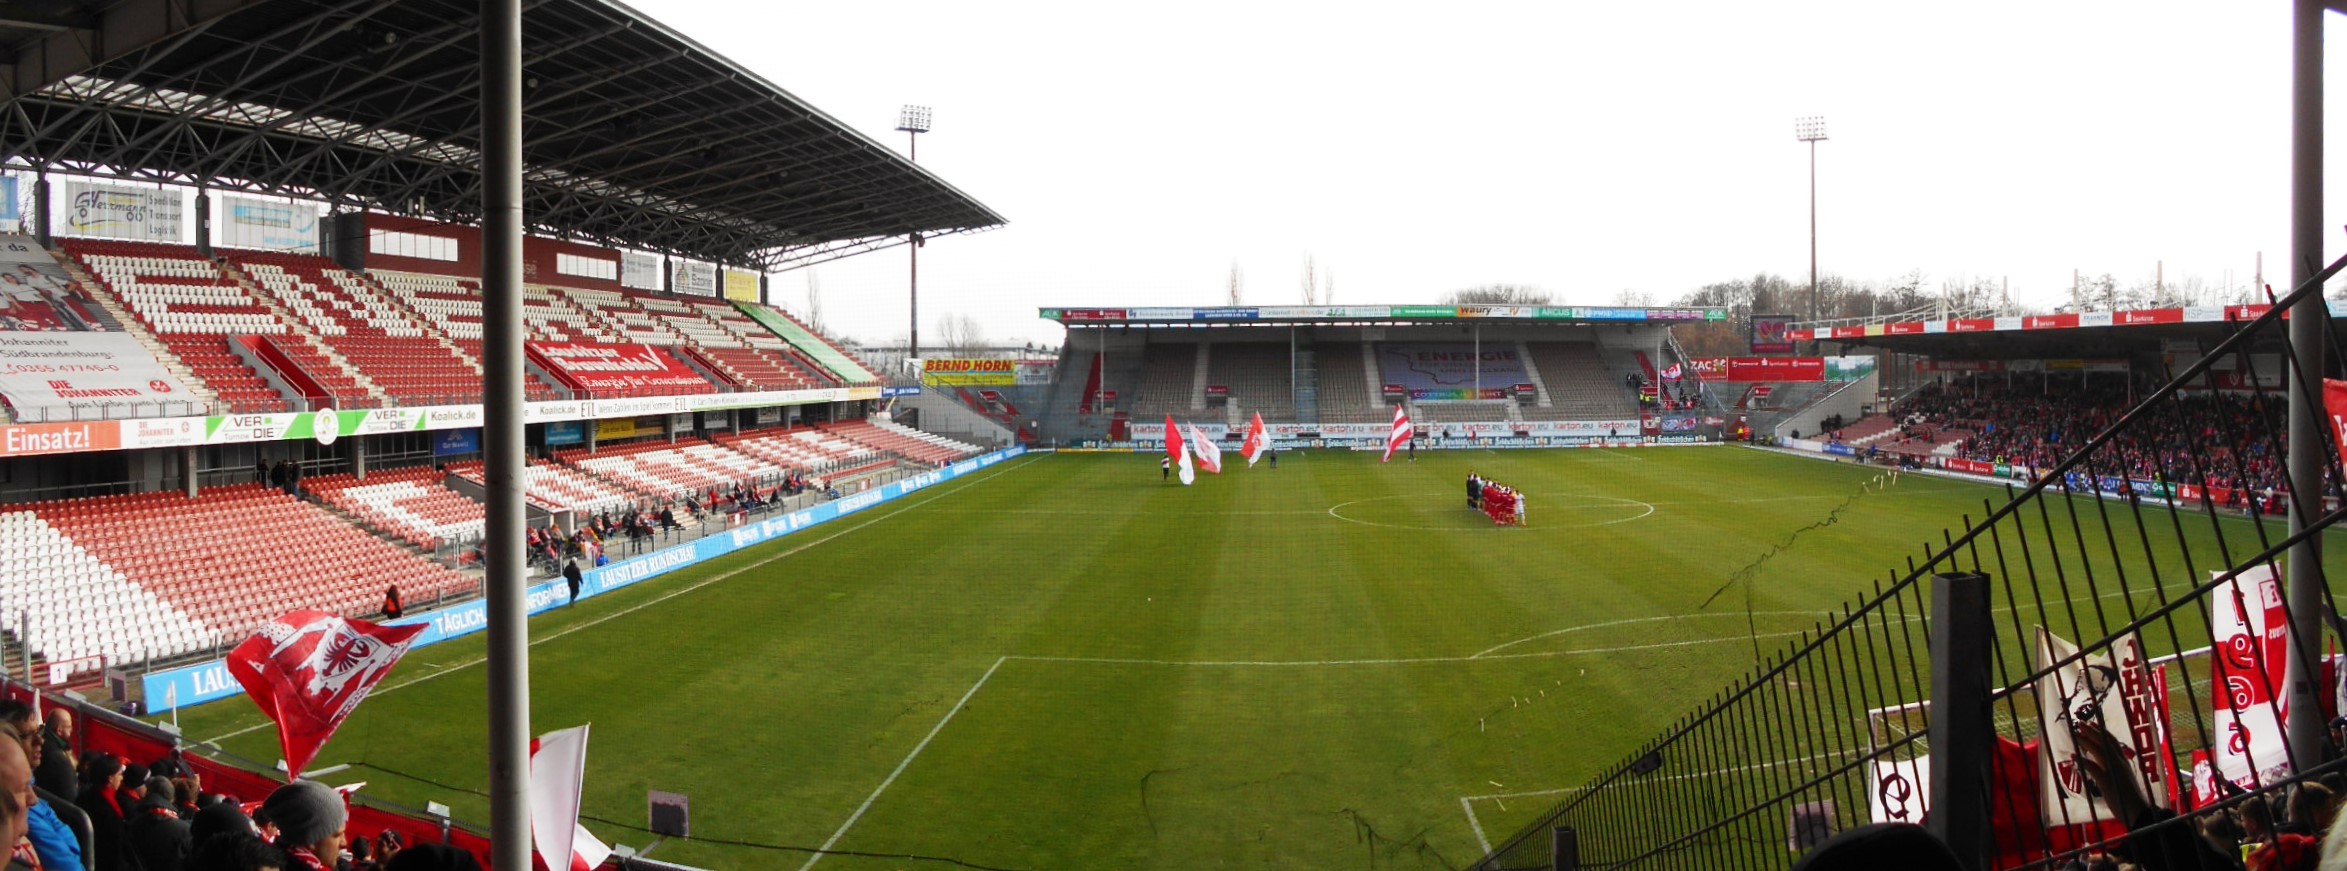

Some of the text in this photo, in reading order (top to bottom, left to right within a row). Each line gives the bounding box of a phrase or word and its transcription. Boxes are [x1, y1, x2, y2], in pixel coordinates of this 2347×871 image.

[531, 343, 621, 357] Lausitzer
[1417, 351, 1517, 361] ENERGIE
[925, 360, 1013, 372] BERND HORN
[1690, 361, 1712, 370] ZAC
[47, 379, 73, 390] DIE
[55, 388, 143, 399] JOHANNITER
[540, 404, 576, 415] Koalick.de
[581, 402, 597, 418] ETL
[375, 410, 398, 420] VER
[431, 410, 477, 421] Koalick.de
[234, 416, 262, 427] VER
[389, 421, 407, 430] DIE
[1508, 422, 1549, 431] karton.eu
[1554, 421, 1594, 430] karton.eu
[1599, 421, 1638, 430] karton.eu
[1276, 424, 1317, 433] karton.eu
[1462, 423, 1503, 432] karton.eu
[6, 424, 90, 452] Einsatz!
[253, 428, 275, 438] DIE
[600, 545, 697, 588] LAUSITZER RUNDSCHAU
